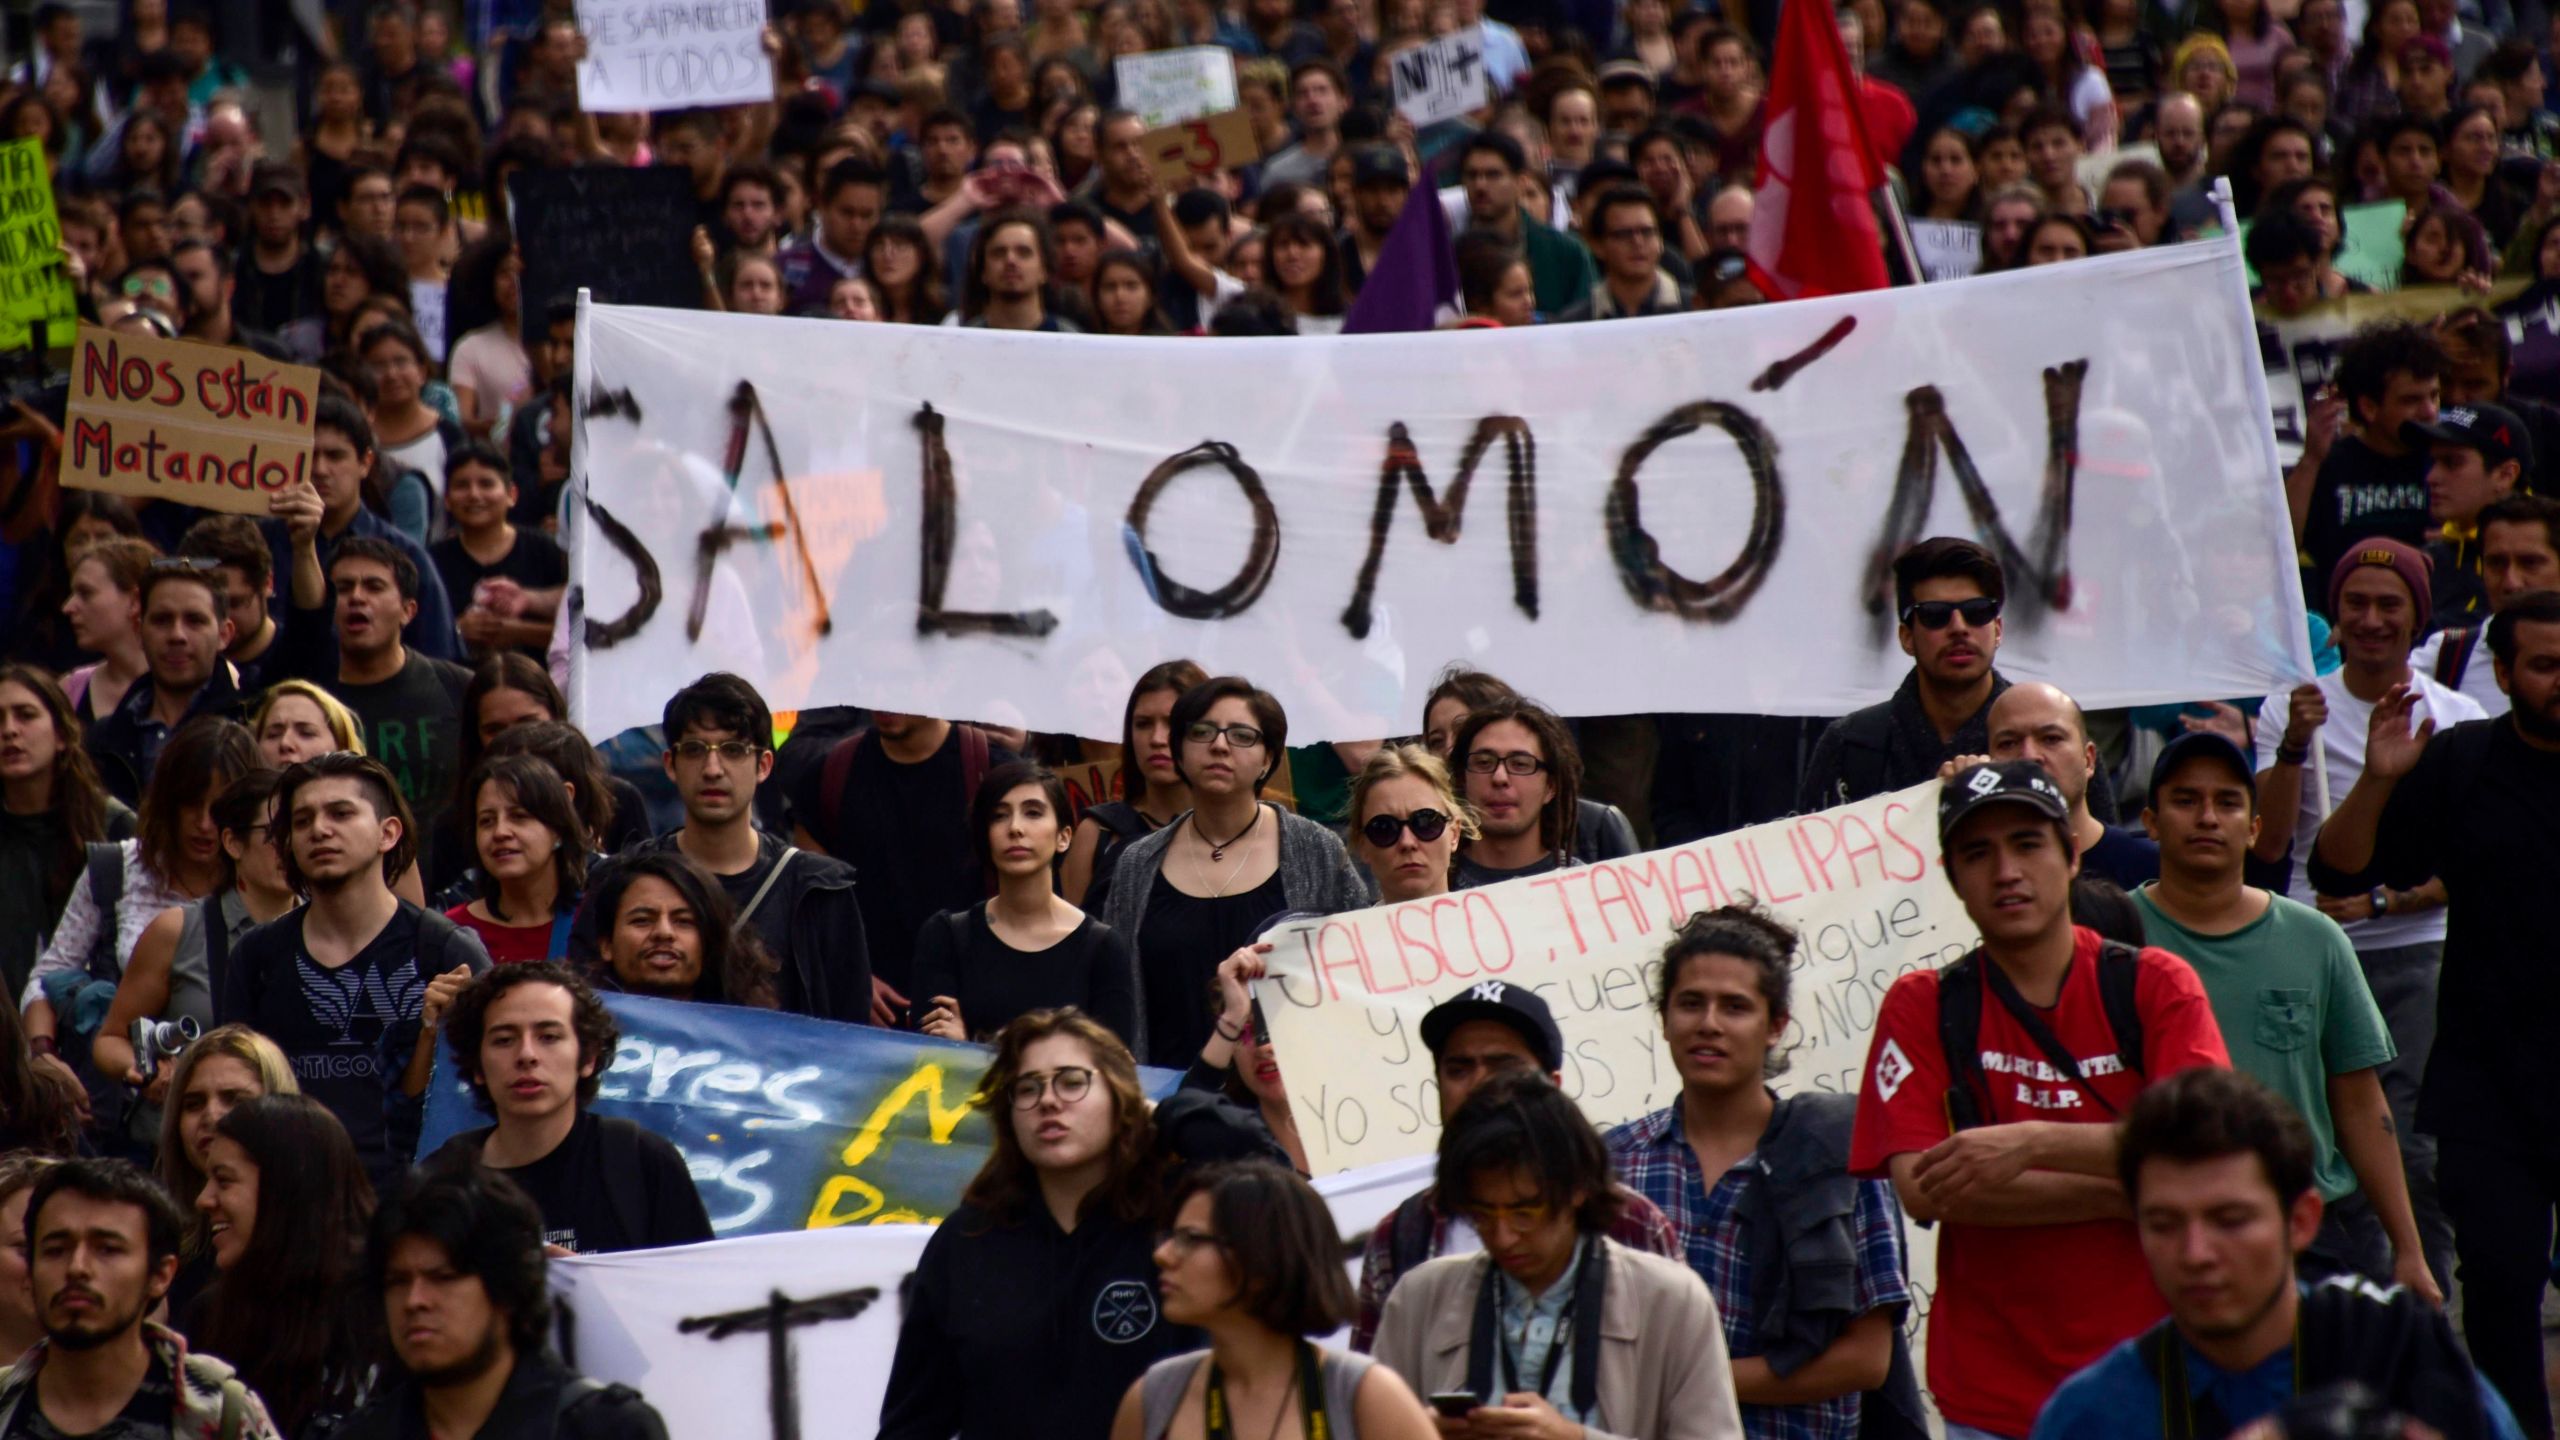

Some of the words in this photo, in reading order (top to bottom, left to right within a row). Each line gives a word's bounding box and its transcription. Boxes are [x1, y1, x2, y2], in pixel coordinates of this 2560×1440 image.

[627, 38, 760, 99] TODOS
[84, 338, 185, 407] Nos
[196, 357, 309, 426] están
[577, 316, 2092, 652] SALOMÓN
[1270, 892, 1515, 1009] JALISCO
[1301, 1083, 1368, 1155] YO
